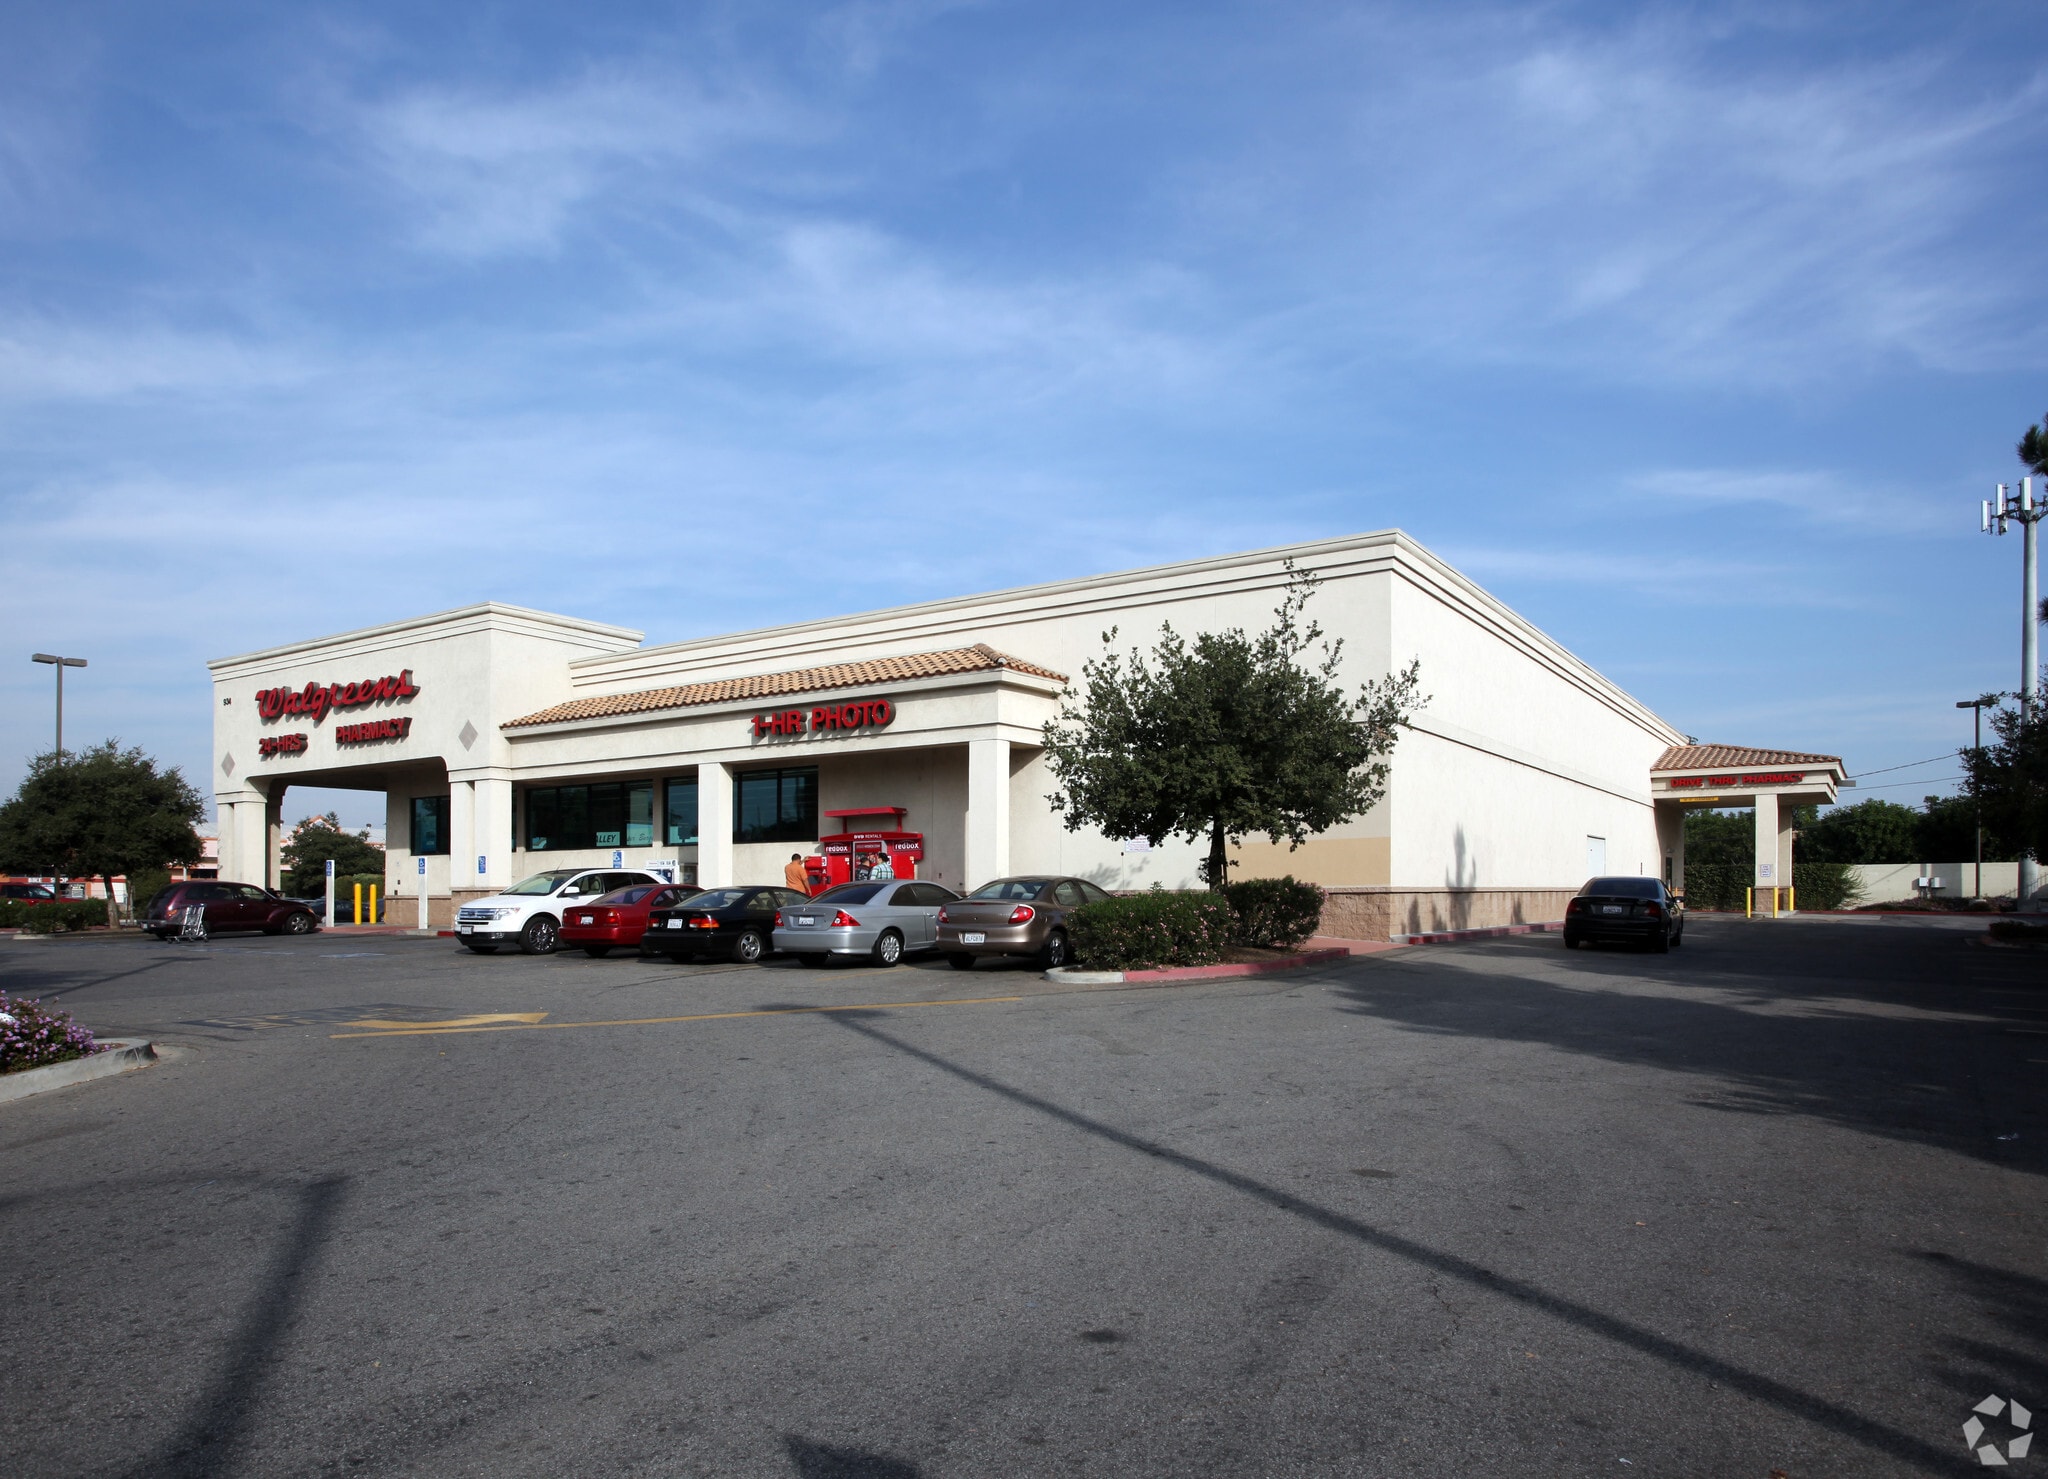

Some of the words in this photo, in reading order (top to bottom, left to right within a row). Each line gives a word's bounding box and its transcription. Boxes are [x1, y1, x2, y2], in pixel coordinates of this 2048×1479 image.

[255, 669, 418, 721] Walgreens
[751, 710, 803, 737] 1-HR
[811, 698, 892, 731] PHOTO
[336, 717, 408, 744] PHARMACY
[258, 733, 304, 755] 24-HRS
[1670, 777, 1704, 788] DRIVE
[1708, 775, 1739, 786] THRU
[1741, 772, 1806, 785] PHARMACY
[825, 844, 848, 853] redbox
[895, 841, 920, 850] redbox
